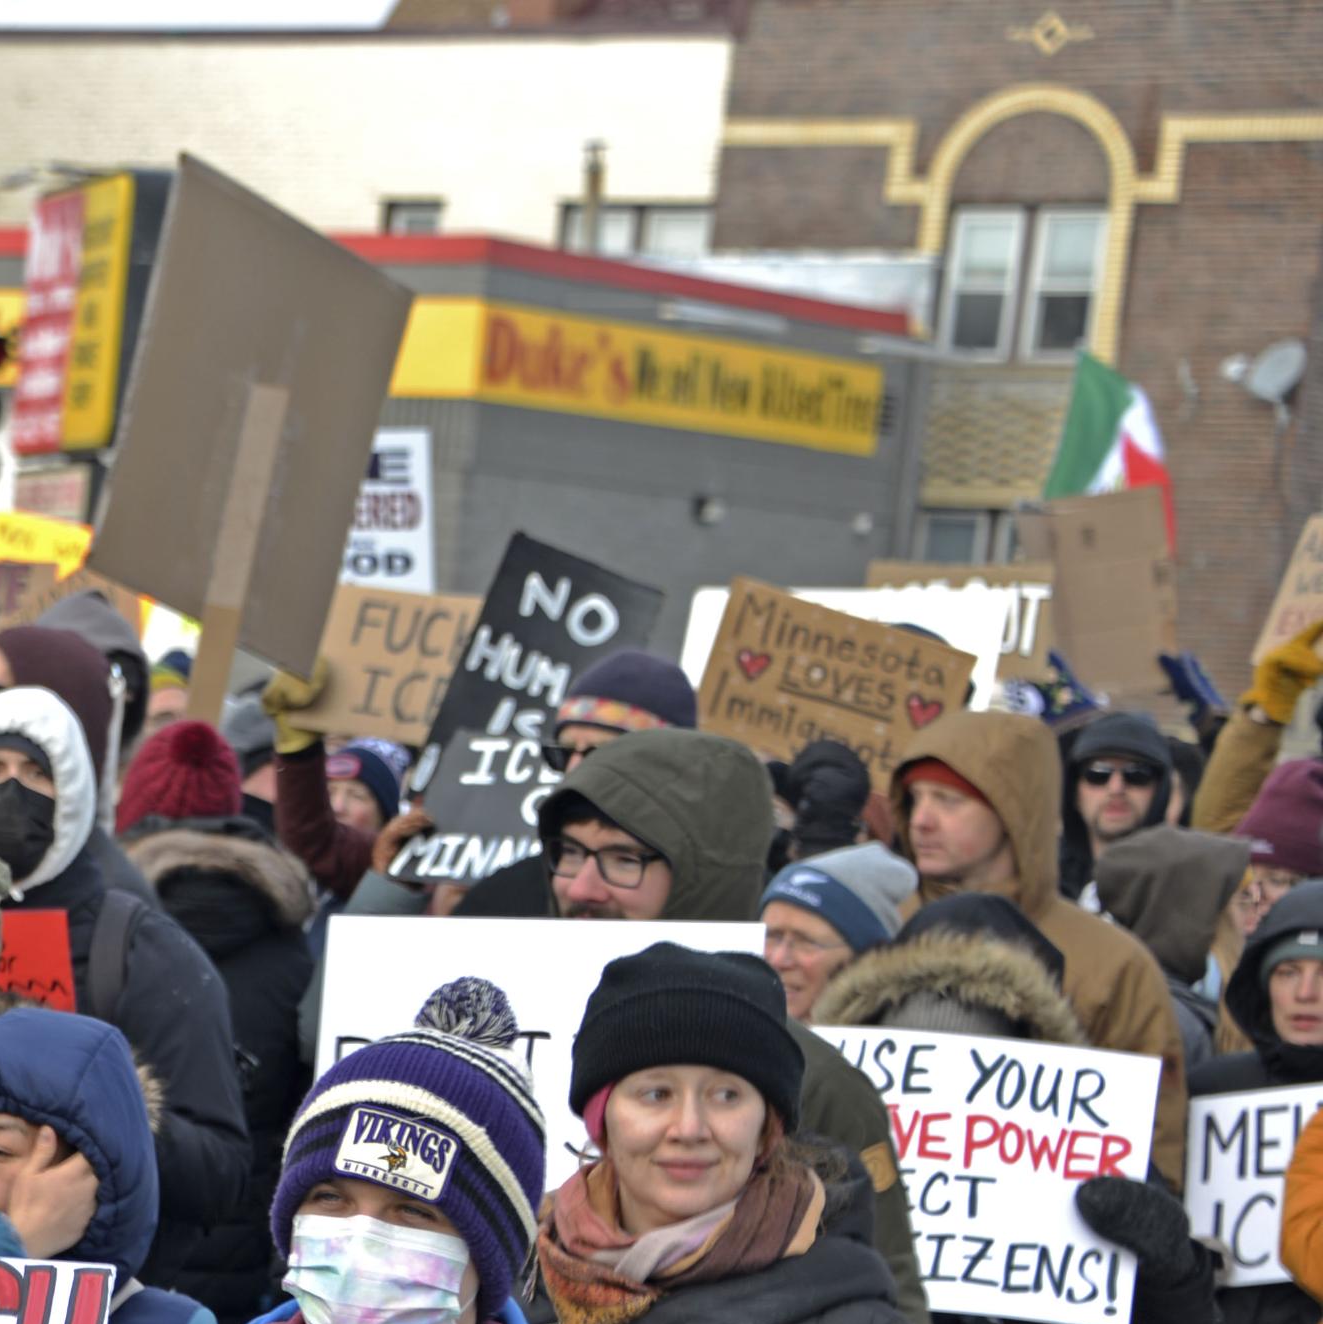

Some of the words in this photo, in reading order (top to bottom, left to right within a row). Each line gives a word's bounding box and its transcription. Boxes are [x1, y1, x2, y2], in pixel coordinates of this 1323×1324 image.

[355, 491, 423, 531] ERED
[519, 571, 620, 647] NO
[732, 591, 946, 688] Minnesota
[464, 624, 571, 706] HUM
[782, 656, 895, 712] LOVES
[966, 1049, 1108, 1127] YOUR
[353, 1110, 452, 1174] VIKINGS
[964, 1114, 1132, 1180] POWER
[342, 1160, 430, 1197] MINNESOTA
